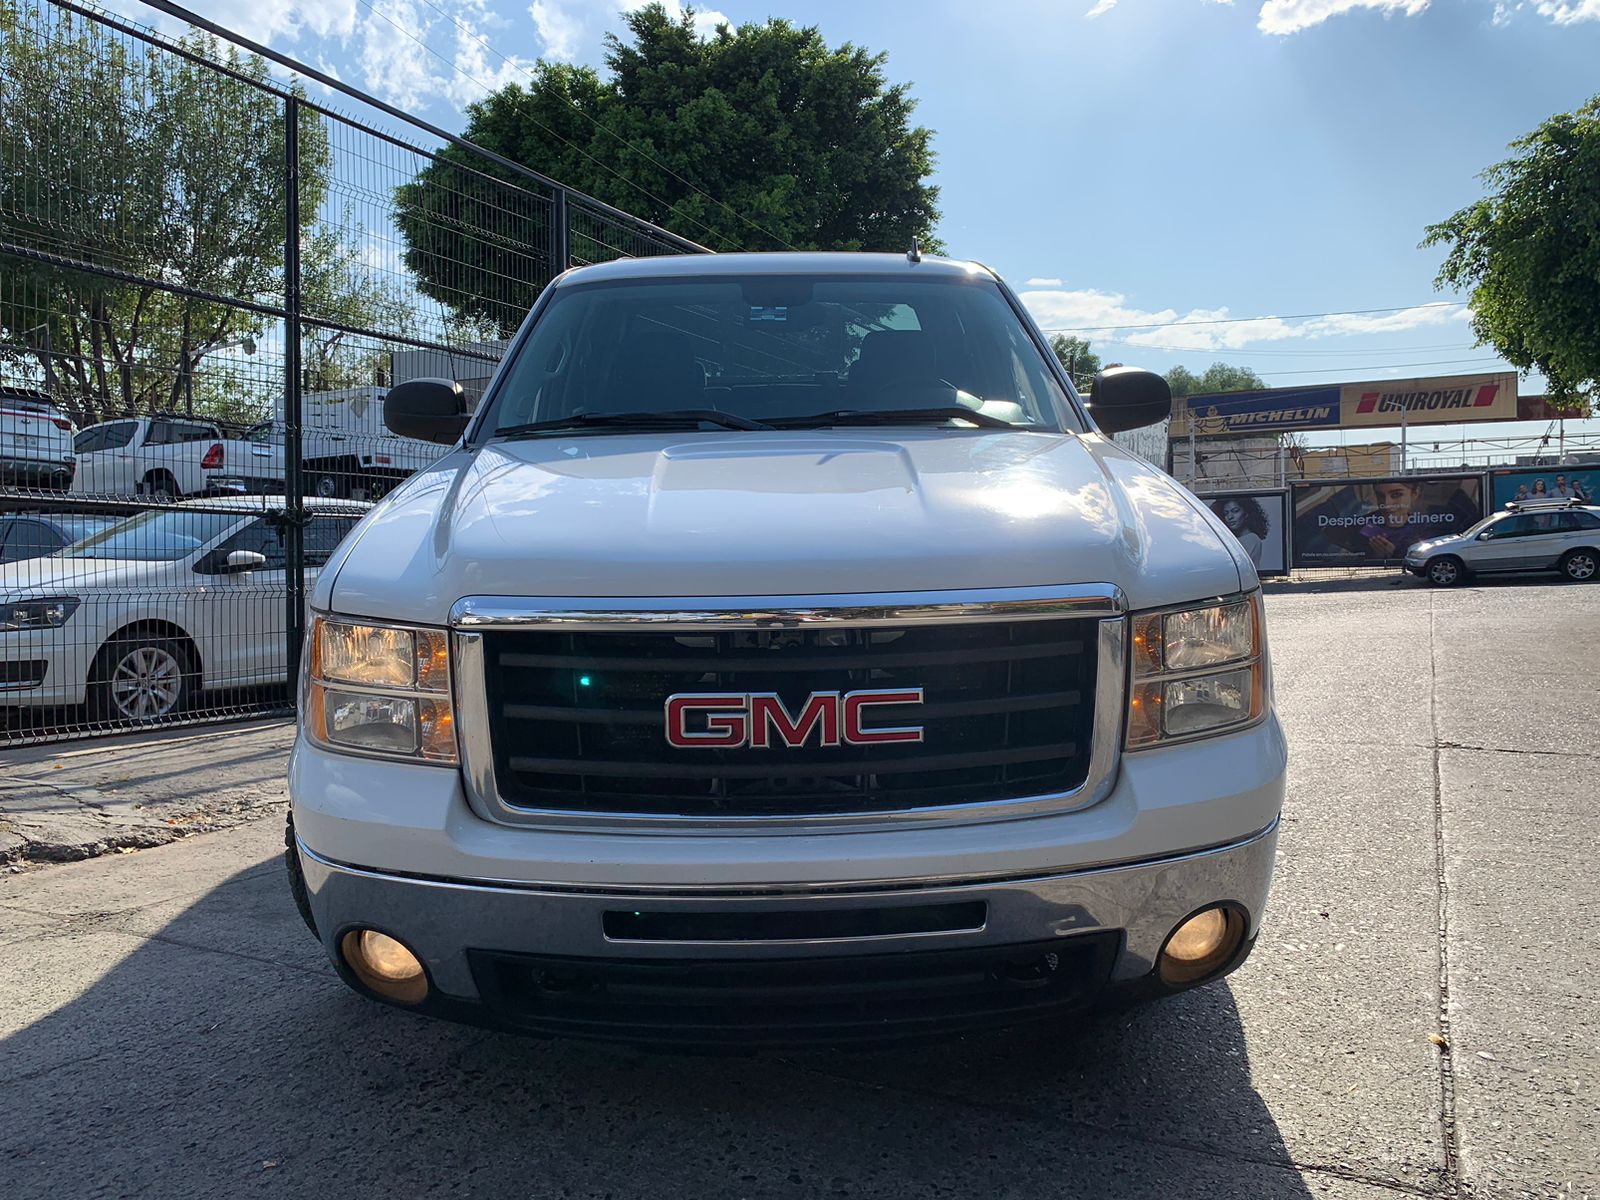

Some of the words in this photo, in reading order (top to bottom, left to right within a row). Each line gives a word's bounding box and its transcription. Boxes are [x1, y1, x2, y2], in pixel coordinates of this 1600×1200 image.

[1378, 389, 1473, 413] UNIROYAL
[1229, 407, 1330, 425] MICHELIN
[1318, 513, 1385, 528] Despierta
[1388, 513, 1404, 525] tu
[1407, 511, 1455, 524] dinero
[664, 687, 924, 749] GMC
